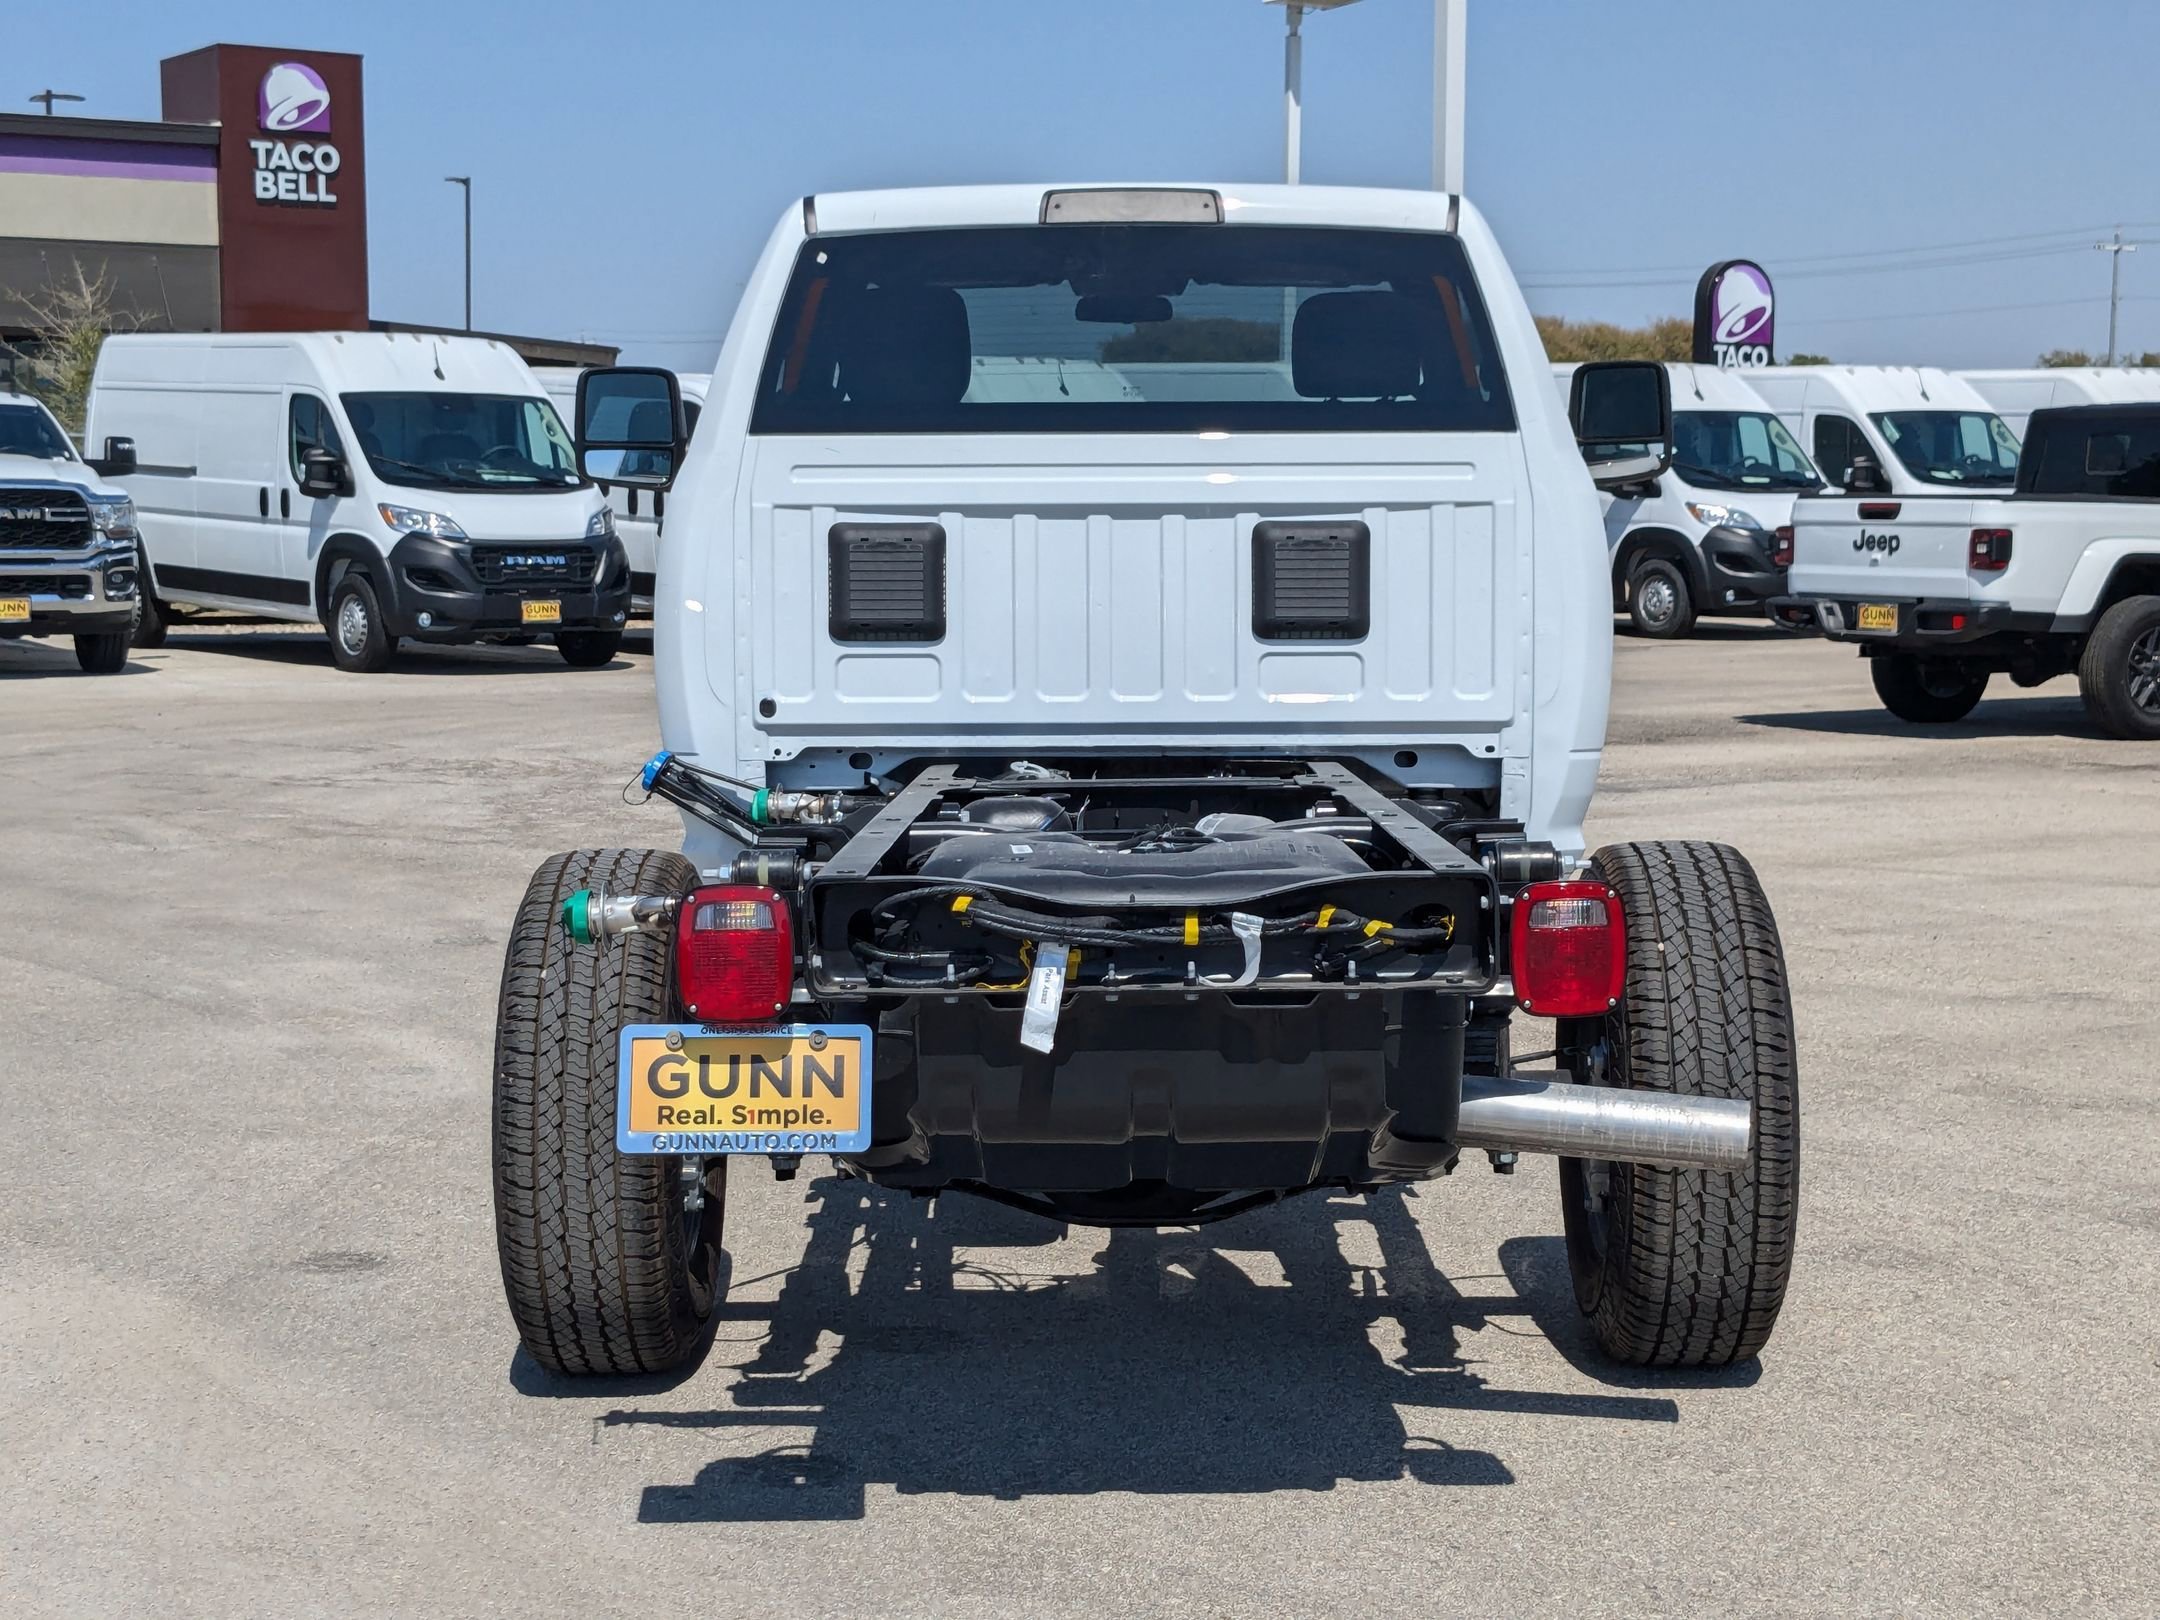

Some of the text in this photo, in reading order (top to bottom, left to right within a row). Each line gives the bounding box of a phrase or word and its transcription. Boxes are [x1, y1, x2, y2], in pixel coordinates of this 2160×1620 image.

[250, 141, 340, 173] TACO
[255, 170, 337, 202] BELL
[1713, 344, 1768, 368] TACO
[0, 508, 41, 519] AM
[1853, 528, 1900, 557] Jeep
[506, 555, 566, 565] RAM
[0, 603, 26, 612] UNN
[526, 604, 557, 613] GUNN
[1862, 608, 1894, 620] GUNN
[647, 1053, 845, 1099] GUNN
[657, 1104, 723, 1125] Real.
[652, 1133, 838, 1150] GUNNAUTO.COM
